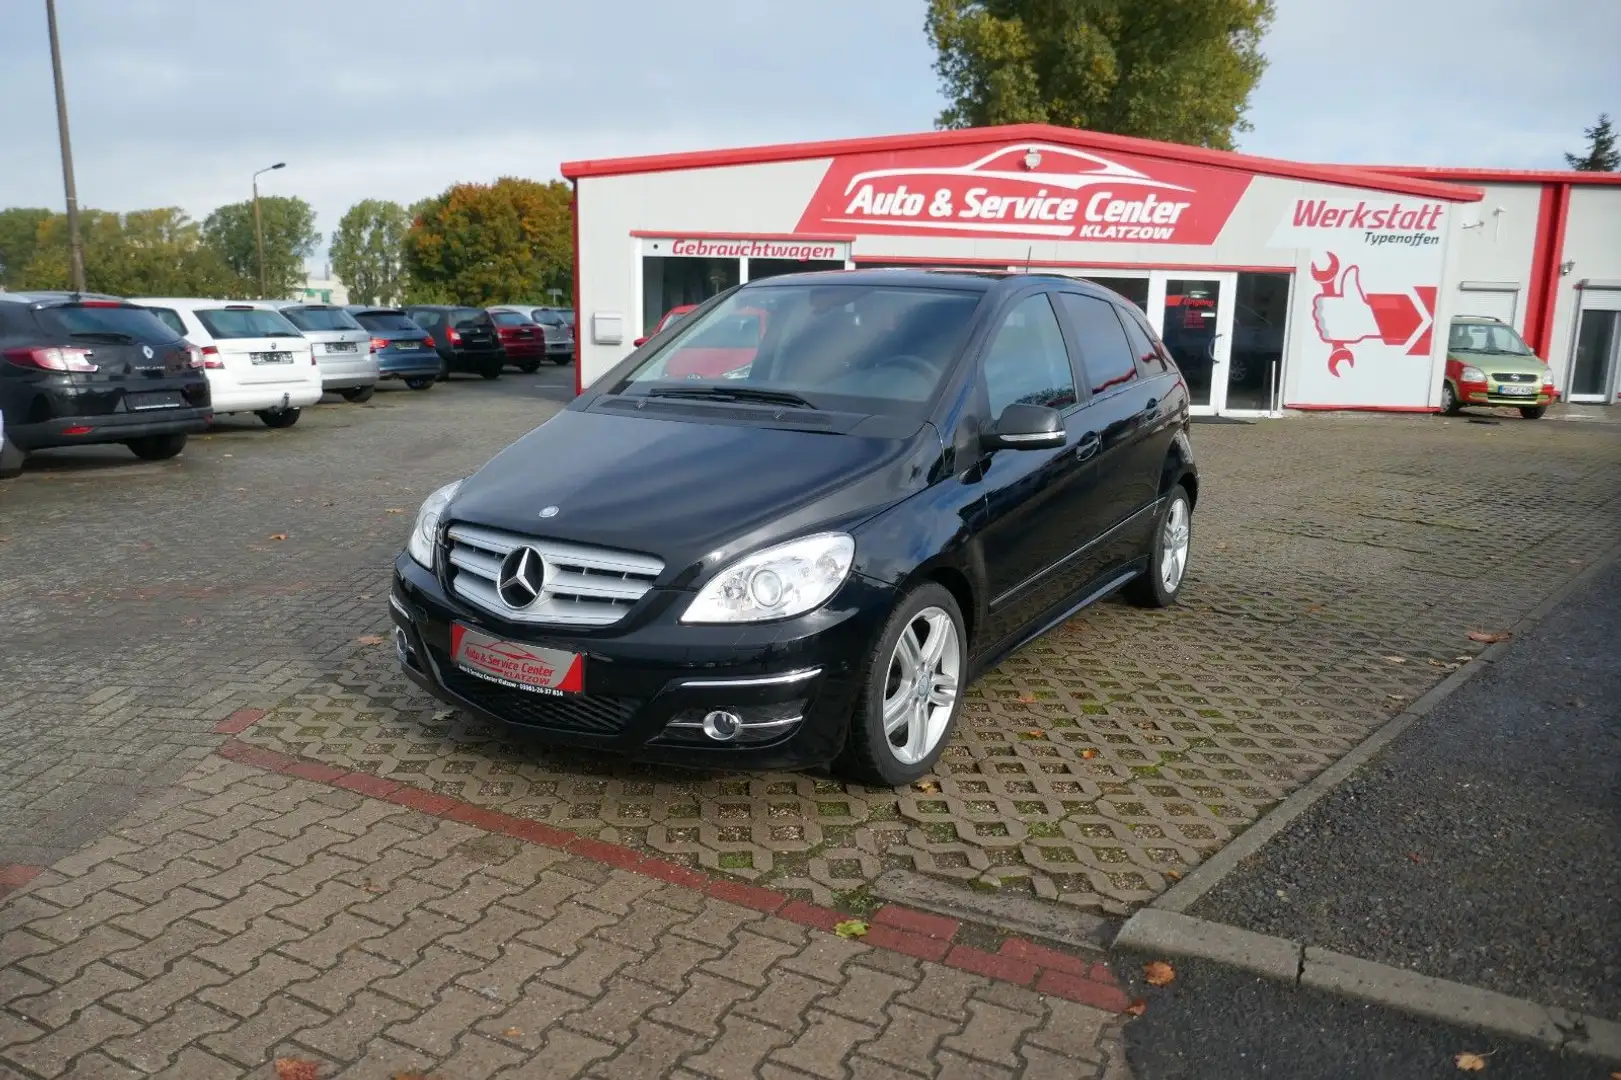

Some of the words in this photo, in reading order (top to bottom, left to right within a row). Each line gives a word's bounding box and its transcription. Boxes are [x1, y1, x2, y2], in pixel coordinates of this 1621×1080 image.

[845, 185, 925, 216] Auto
[929, 188, 953, 218] &
[959, 187, 1078, 220] Service
[1086, 191, 1191, 225] Center
[1293, 199, 1444, 230] Werkstatt
[1079, 225, 1175, 240] KLATZOW
[1364, 231, 1439, 246] Typenoffen
[672, 239, 835, 262] Gebrauchtwagen
[464, 646, 481, 661] Auto
[486, 654, 519, 671] Service
[521, 662, 555, 677] Center
[503, 670, 551, 685] KLATZOW
